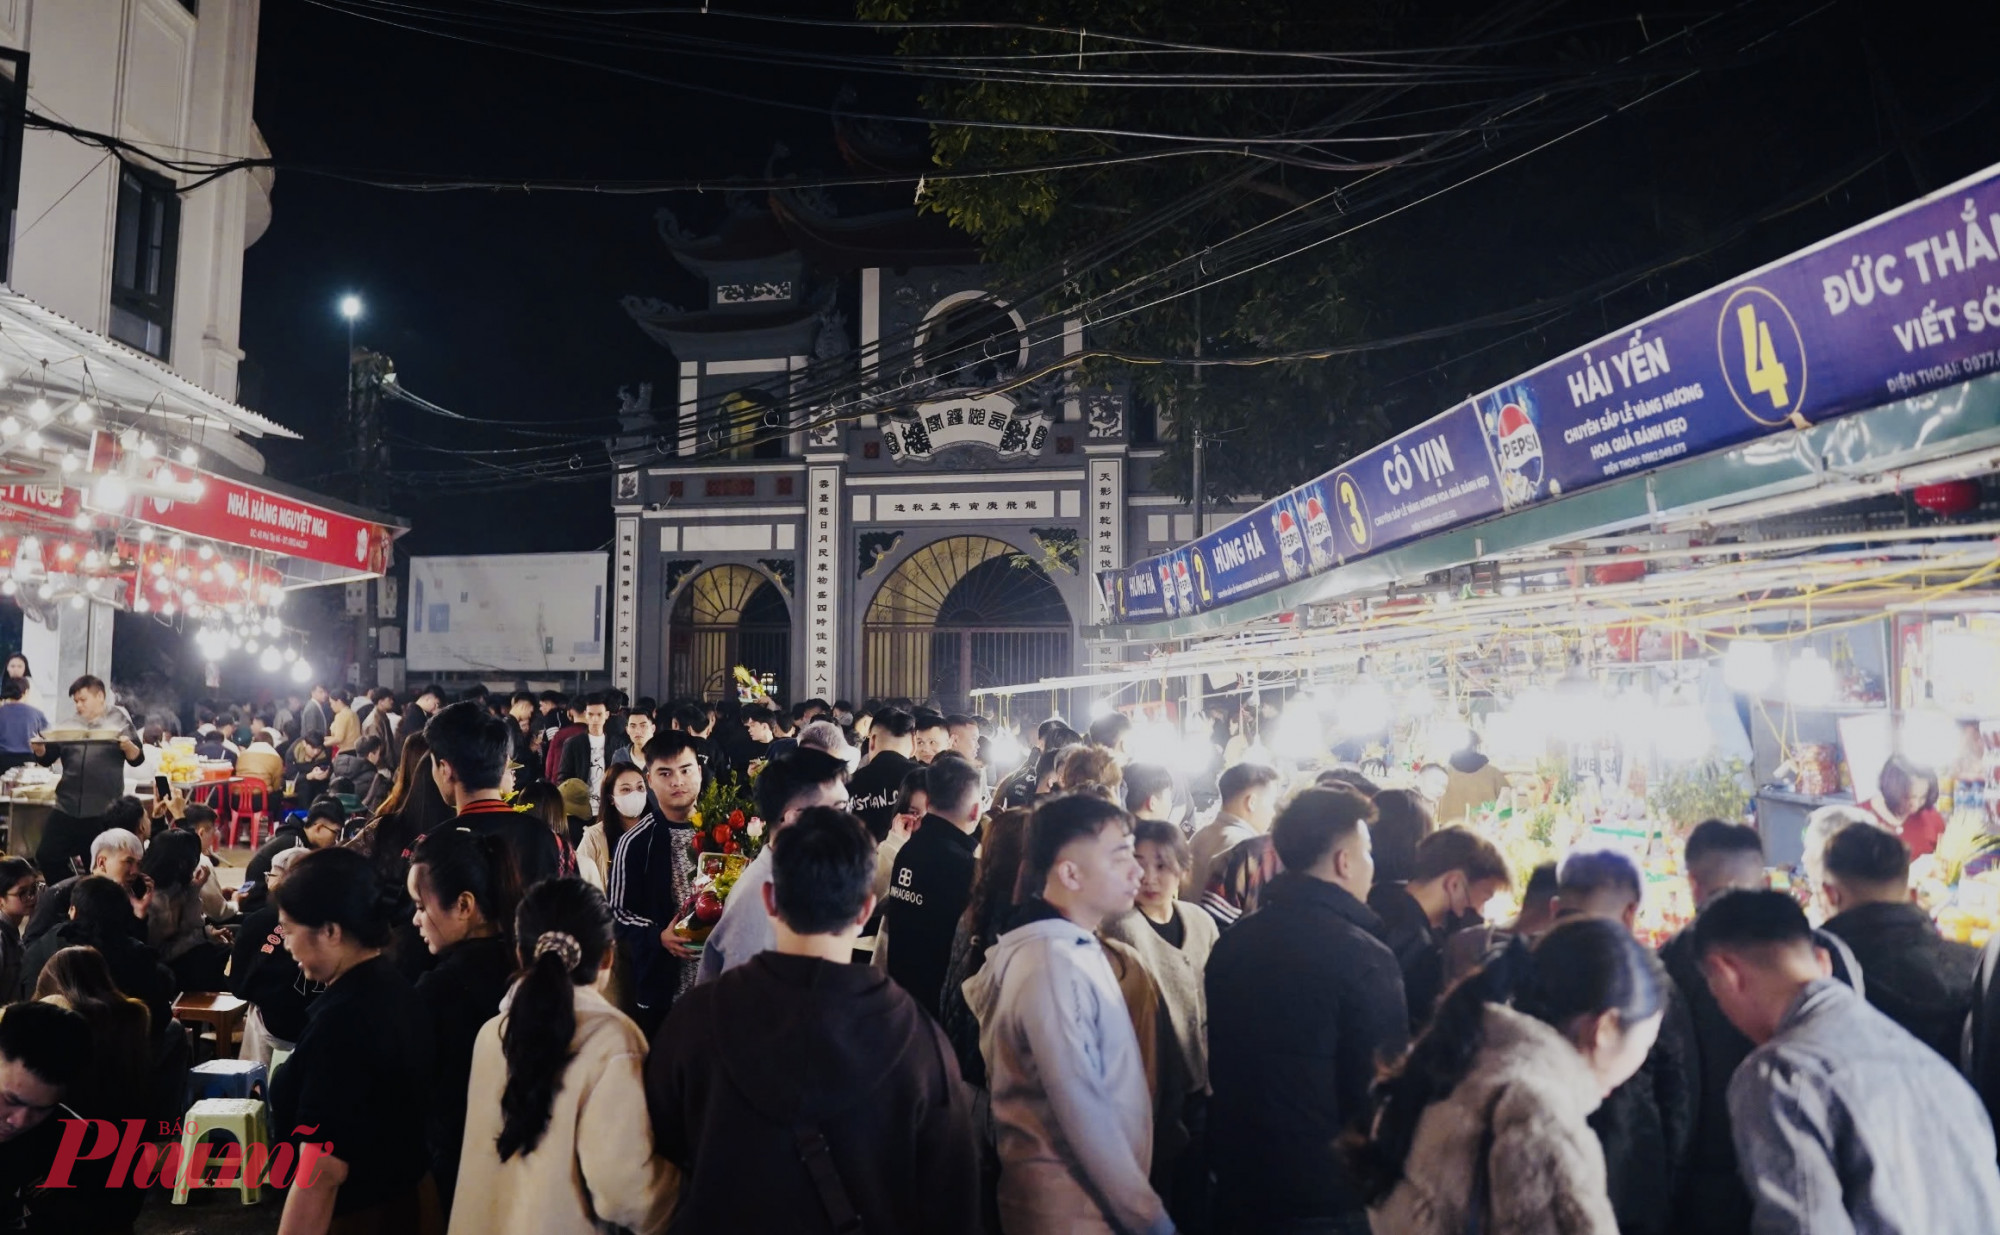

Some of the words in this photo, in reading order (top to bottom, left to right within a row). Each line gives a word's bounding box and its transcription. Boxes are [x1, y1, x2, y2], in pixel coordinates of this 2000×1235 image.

[1822, 254, 1904, 317] ĐỨC
[1892, 299, 1956, 353] VIẾT
[1566, 352, 1613, 407] HẢI
[1611, 329, 1671, 388] YẾN
[1737, 303, 1790, 409] 4
[1382, 445, 1413, 495] CÔ
[1410, 434, 1455, 488] VỊN
[1503, 433, 1539, 460] PEPSI
[1590, 442, 1612, 460] HOA
[227, 491, 250, 519] NHÀ
[250, 496, 278, 525] HÀNG
[279, 508, 313, 536] NGUYỆT
[313, 519, 328, 538] NGA
[1340, 481, 1366, 545] 3
[1212, 537, 1245, 574] HÙNG
[1245, 521, 1267, 562] HÀ
[1193, 553, 1211, 601] 2
